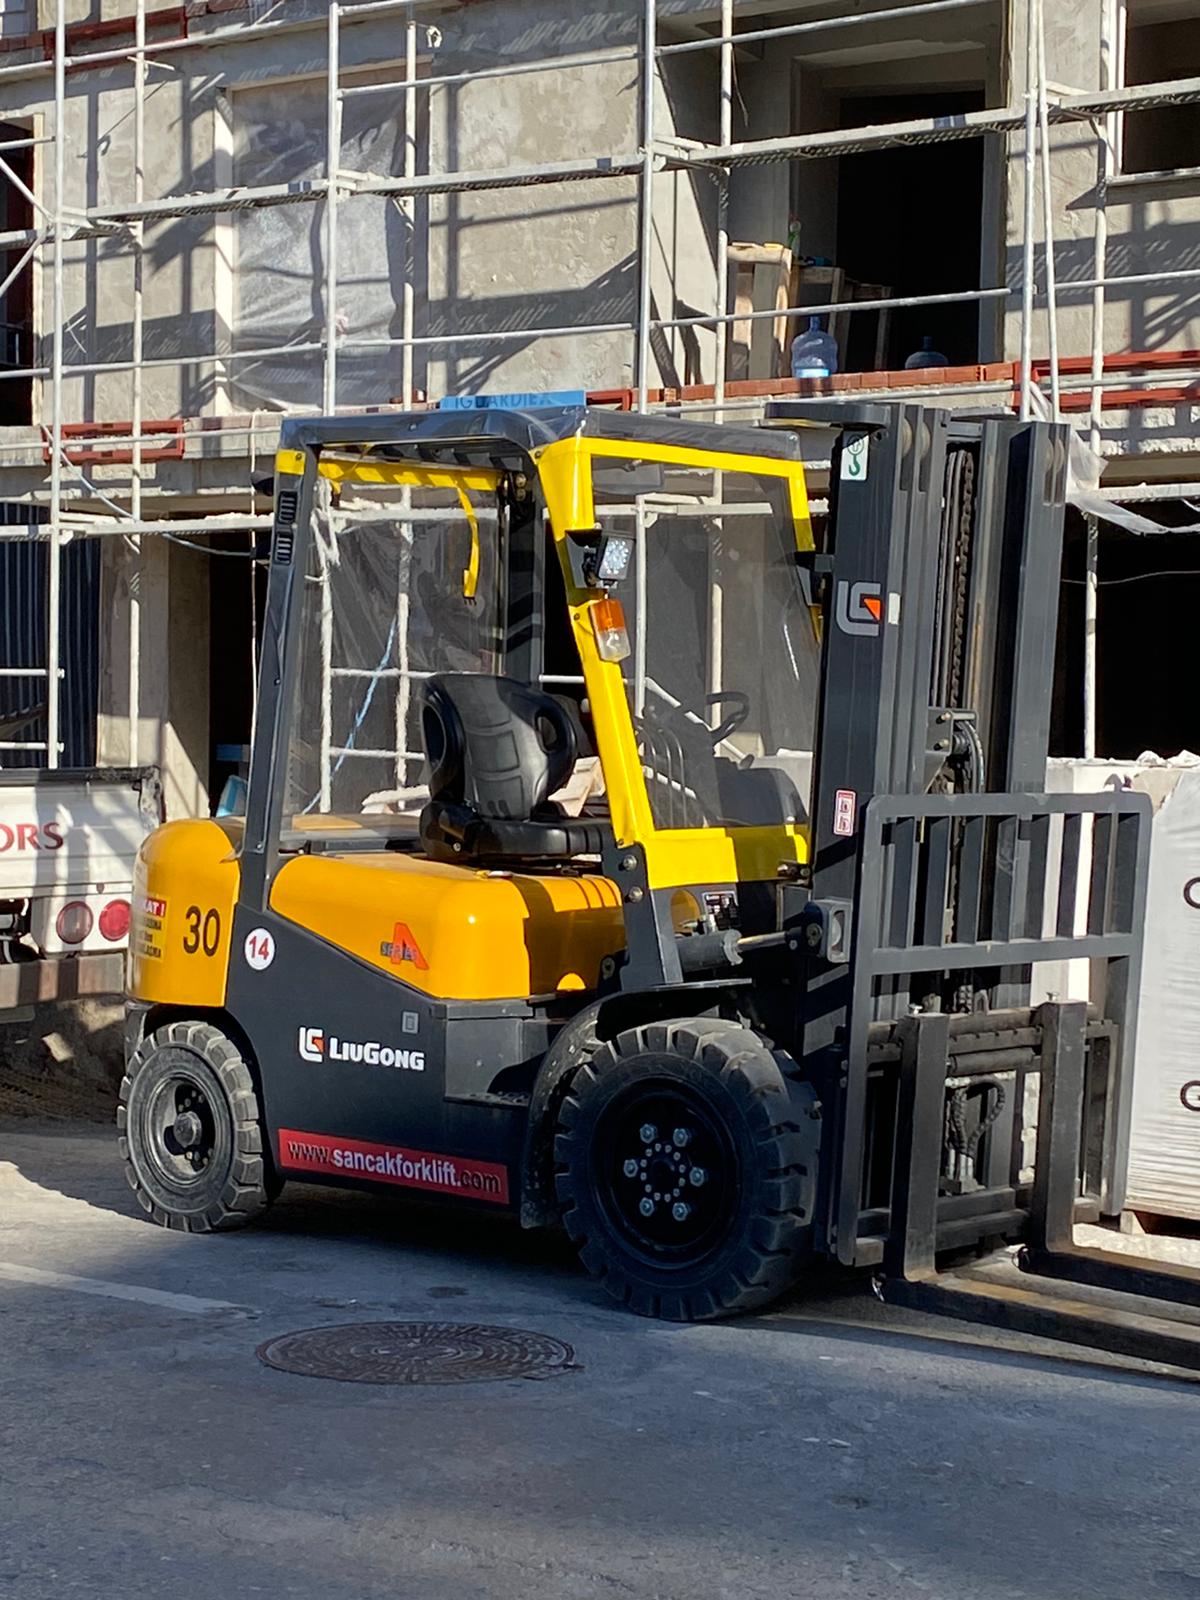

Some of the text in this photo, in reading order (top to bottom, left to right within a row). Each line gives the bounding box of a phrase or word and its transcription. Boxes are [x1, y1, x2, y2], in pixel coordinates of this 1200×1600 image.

[183, 905, 221, 957] 30
[249, 935, 270, 960] 14
[287, 1140, 502, 1194] www.sancakforklift.com
